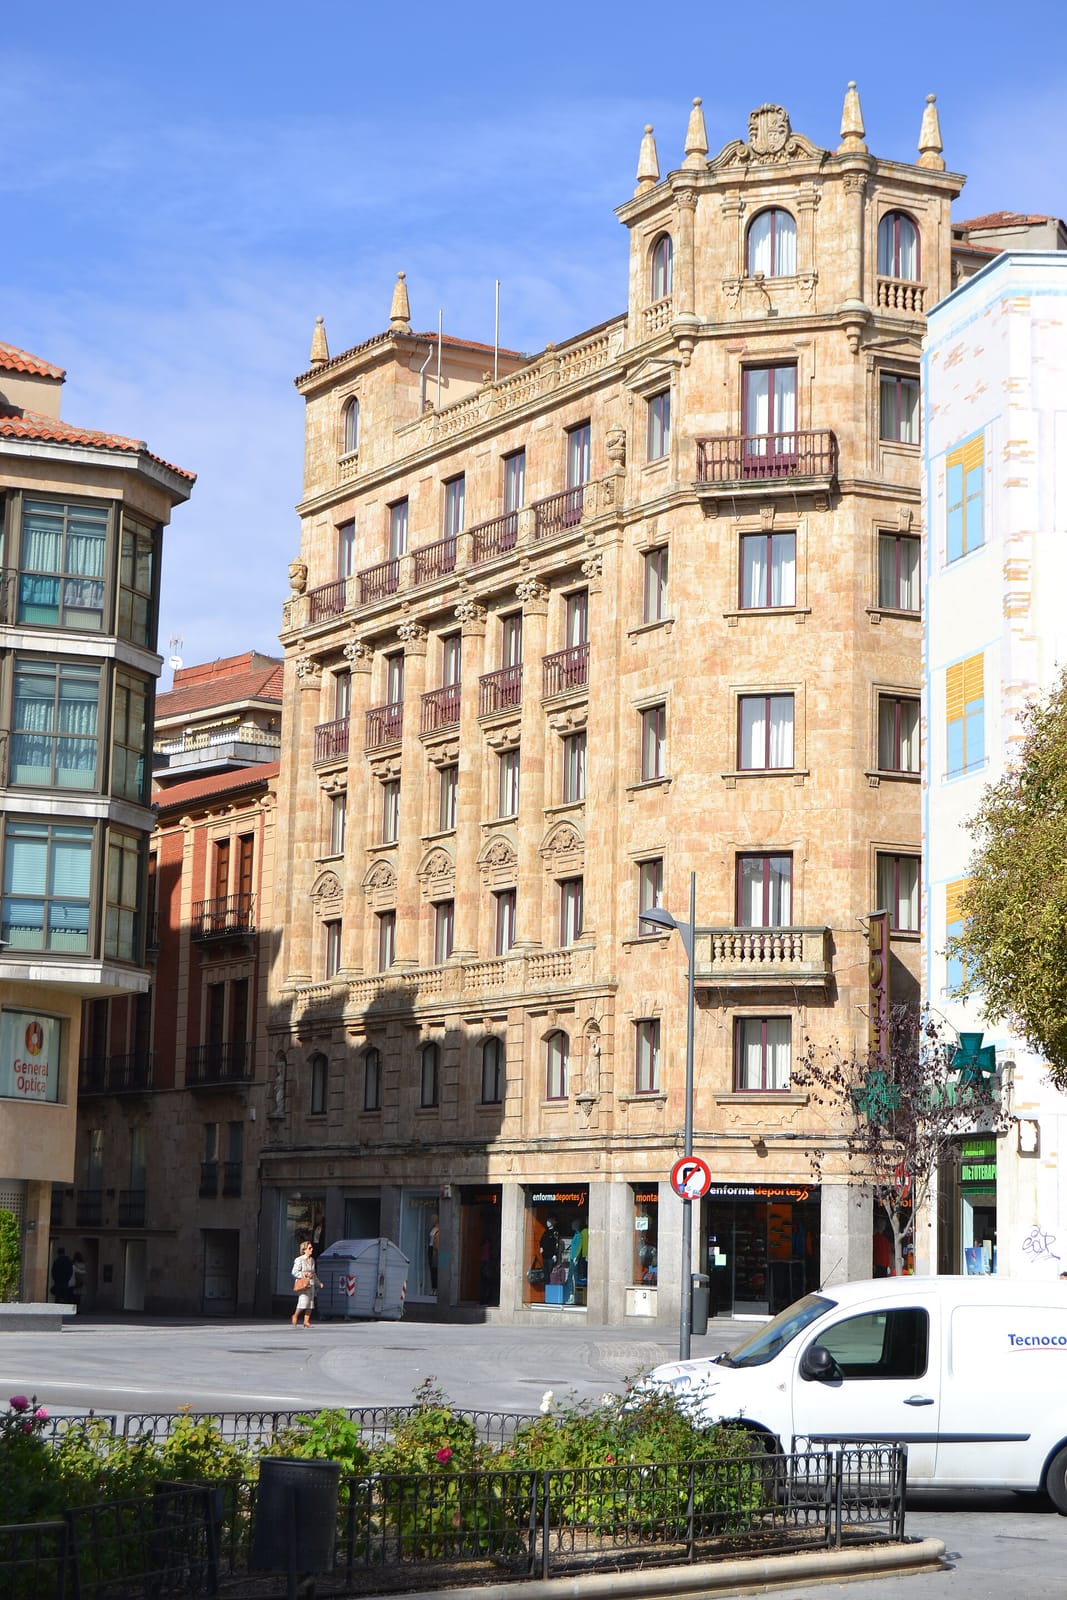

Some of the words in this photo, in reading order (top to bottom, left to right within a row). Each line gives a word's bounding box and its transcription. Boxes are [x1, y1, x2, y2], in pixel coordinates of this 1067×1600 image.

[13, 1059, 49, 1077] General
[17, 1076, 46, 1095] Optica
[532, 1192, 580, 1203] enformadeportes
[709, 1184, 801, 1198] enformadeportes
[1007, 1333, 1067, 1346] Tecnoco
